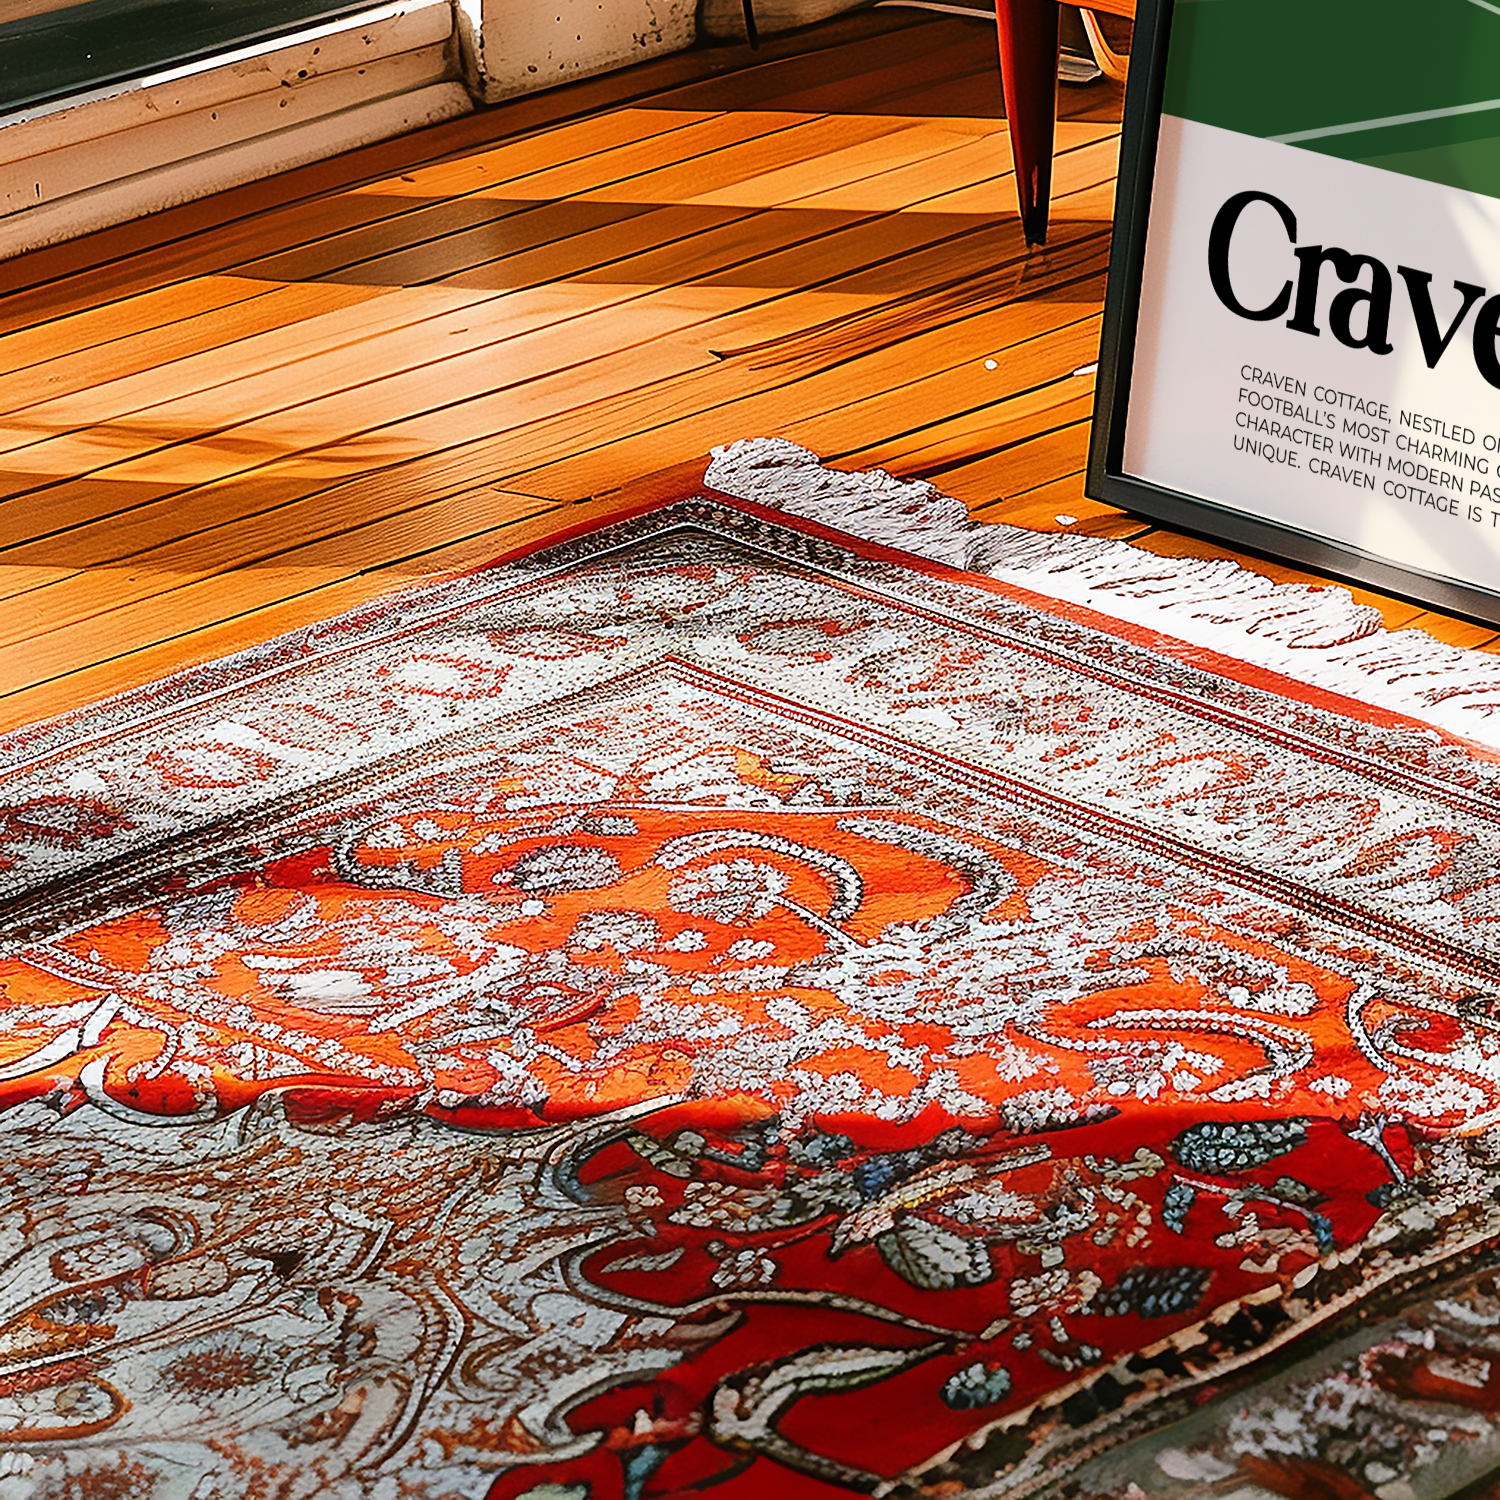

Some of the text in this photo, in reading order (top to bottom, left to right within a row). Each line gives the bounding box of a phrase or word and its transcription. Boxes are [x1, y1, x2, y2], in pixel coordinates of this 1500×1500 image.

[1241, 365, 1306, 397] CRAVEN
[1314, 386, 1391, 424] COTTAGE,
[1400, 410, 1475, 445] NESTLED
[1234, 434, 1300, 468] UNIQUE.
[1309, 458, 1375, 491] CRAVEN
[1383, 480, 1459, 516] COTTAGE
[1468, 505, 1482, 523] IS
[1236, 412, 1333, 454] CHARACTER
[1339, 441, 1381, 468] WITH
[1388, 456, 1463, 492] MODERN
[1343, 418, 1390, 444] MOST
[1396, 434, 1489, 474] CHARMING
